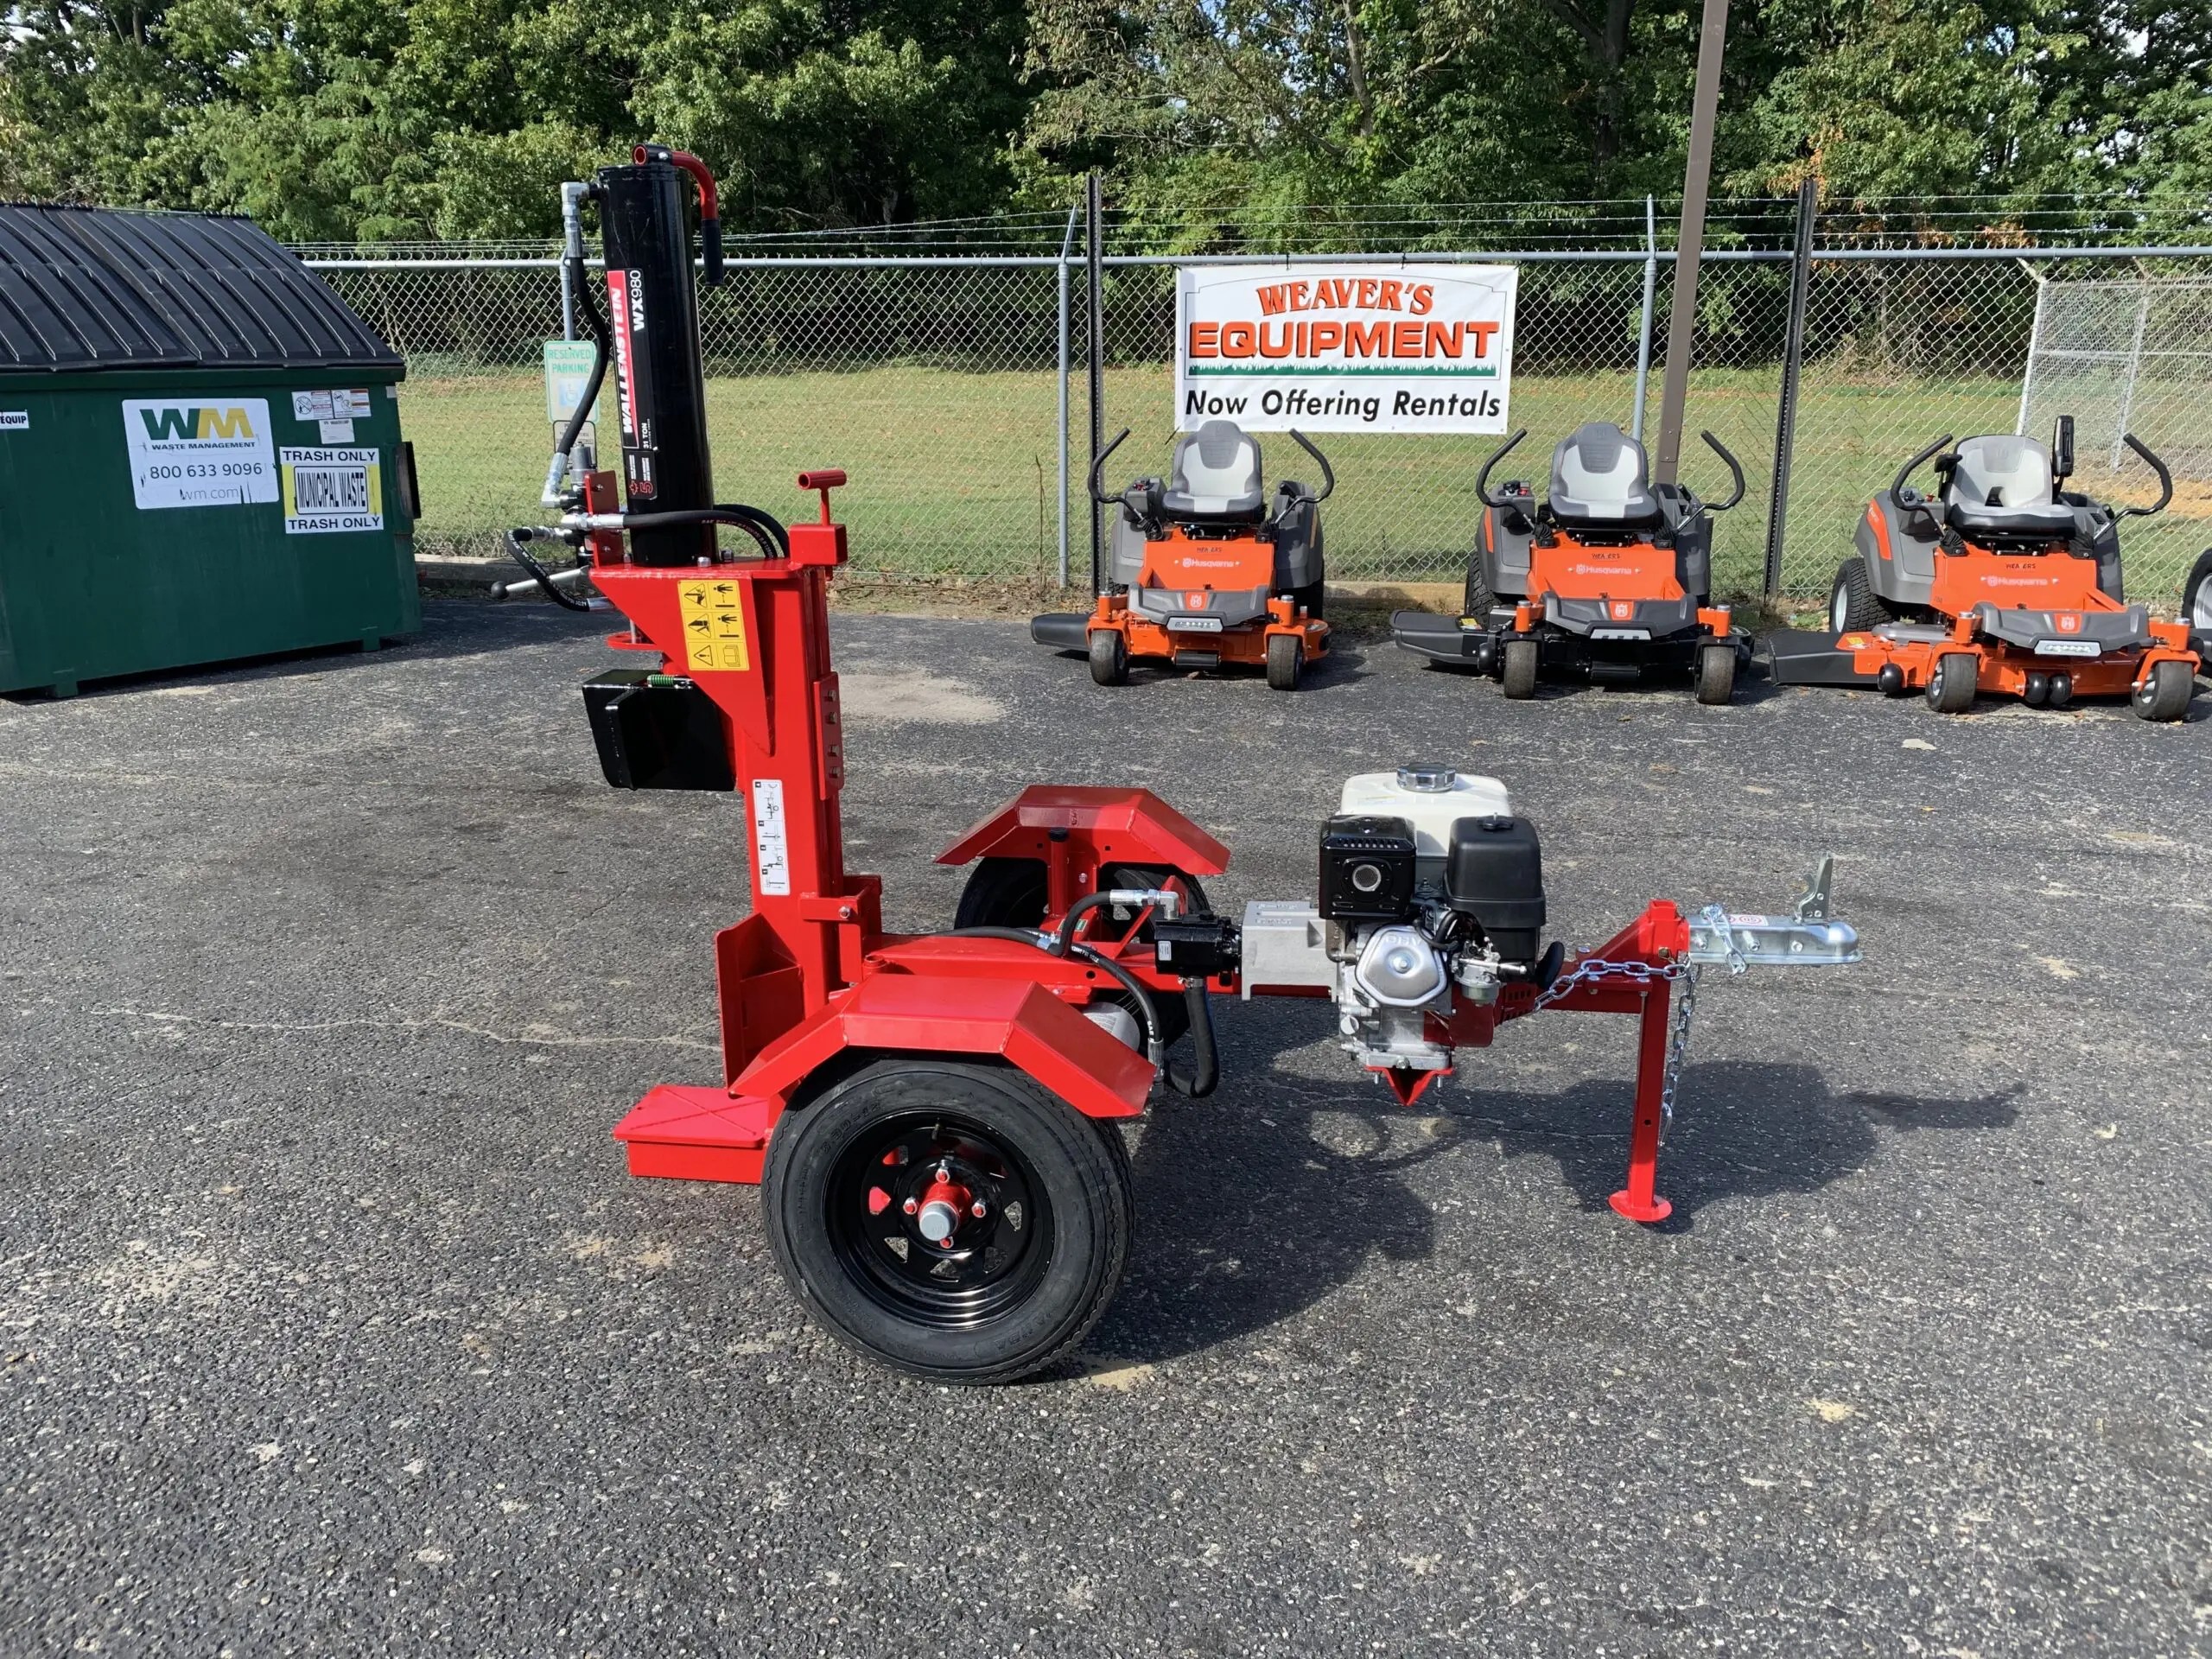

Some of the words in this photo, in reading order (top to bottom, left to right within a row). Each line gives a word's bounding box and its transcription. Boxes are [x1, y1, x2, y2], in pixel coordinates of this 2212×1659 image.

[629, 270, 645, 332] WX980
[1255, 278, 1434, 316] WEAVER'S
[1189, 321, 1501, 359] EQUIPMENT
[548, 349, 591, 359] RESERVED
[611, 287, 633, 433] WALLENSTEIN
[553, 363, 589, 373] PARKING
[1185, 389, 1248, 416] Now
[1261, 388, 1381, 423] Offering
[1392, 390, 1501, 416] Rentals
[139, 407, 254, 441] WM
[283, 450, 334, 461] TRASH
[338, 451, 376, 461] ONLY
[149, 466, 181, 479] 800
[187, 464, 217, 477] 633
[222, 462, 263, 476] 9096
[296, 472, 340, 508] MUNICIPAL
[339, 472, 365, 507] WASTE
[288, 518, 339, 530] TRASH
[342, 517, 380, 528] ONLY
[1192, 558, 1234, 568] Husqvarna
[1586, 566, 1632, 575] Husqvarna
[1998, 577, 2048, 587] Husqvarna
